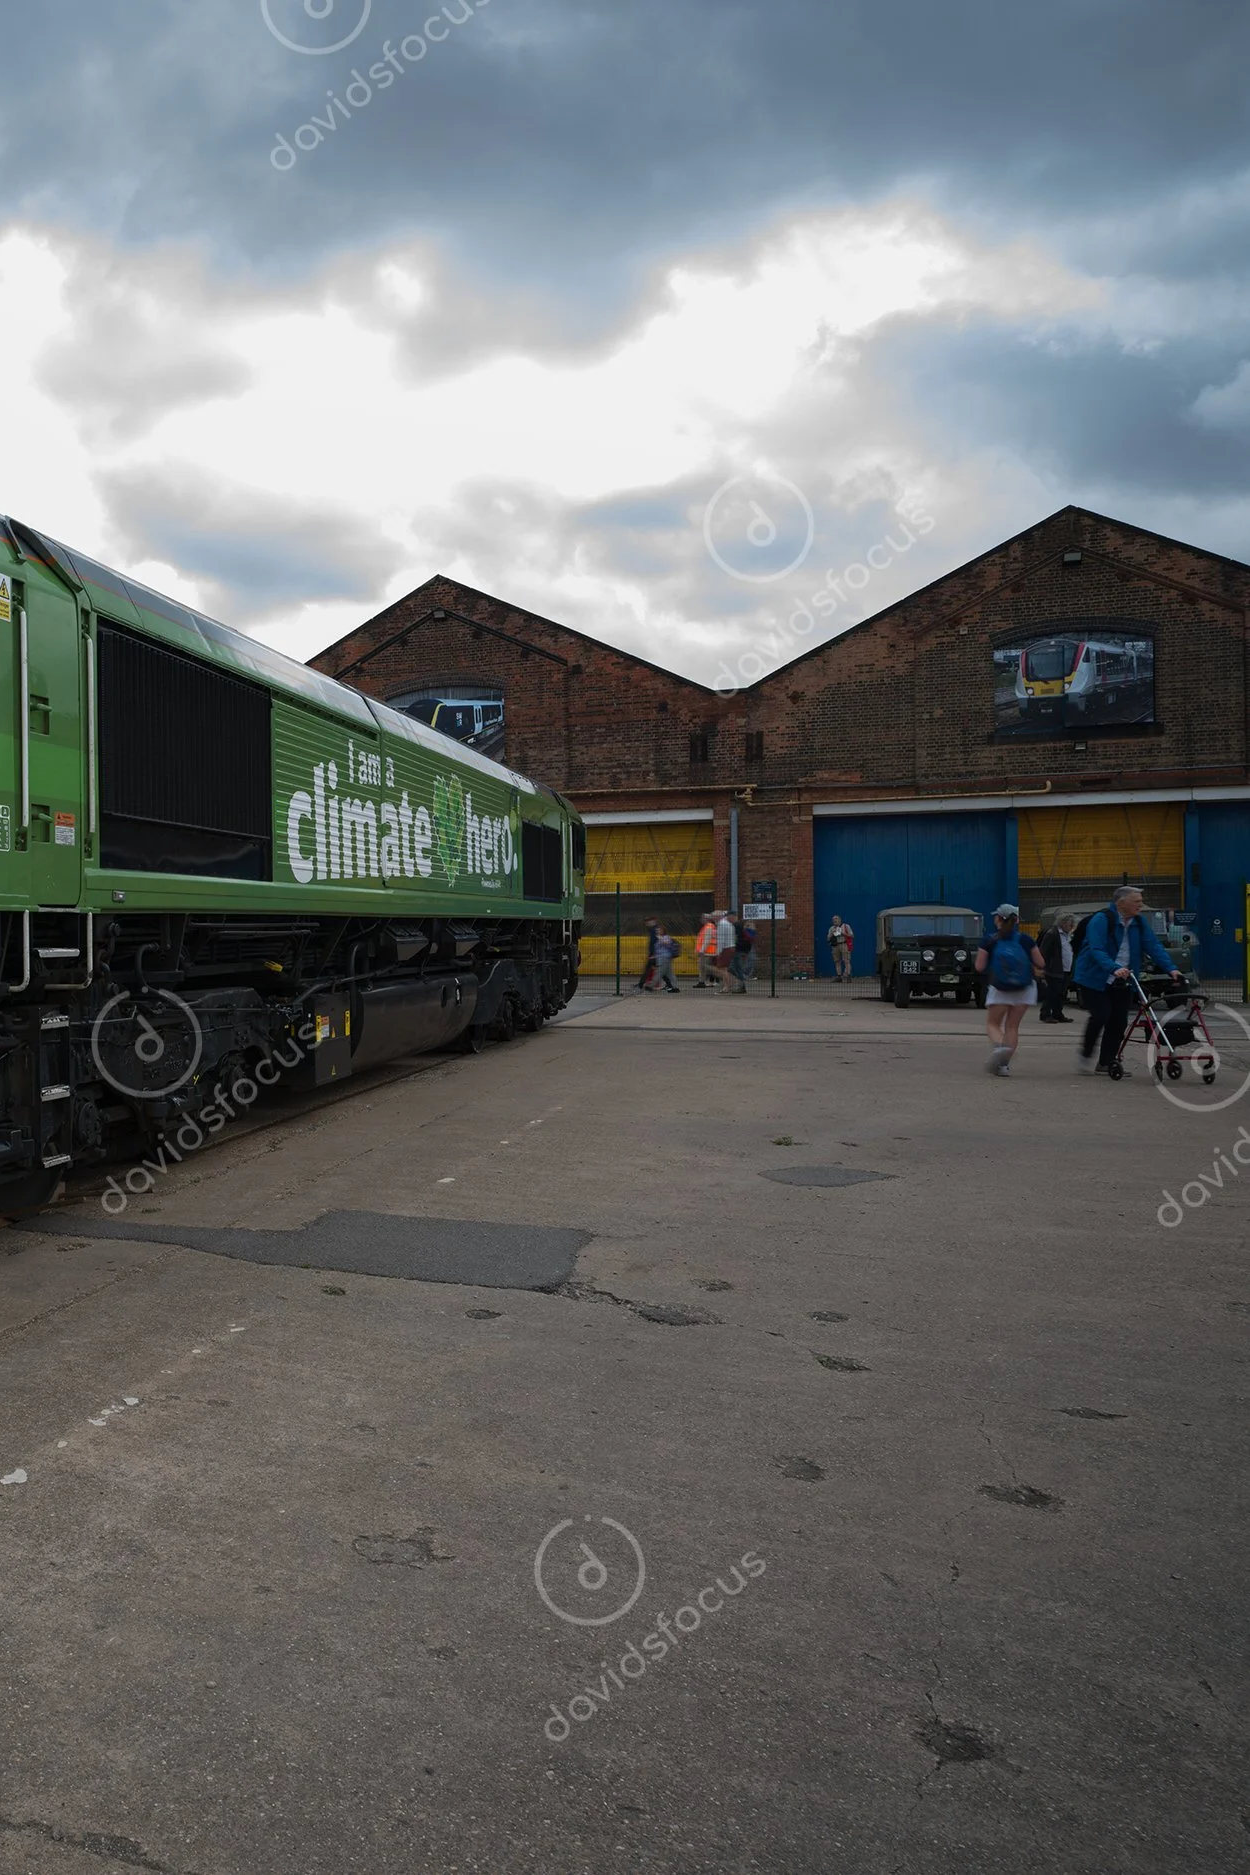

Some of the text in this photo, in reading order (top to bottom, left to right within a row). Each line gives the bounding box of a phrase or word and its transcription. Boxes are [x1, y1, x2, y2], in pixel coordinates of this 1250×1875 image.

[358, 751, 382, 786] am
[385, 756, 395, 788] a
[287, 760, 519, 884] climate hero.
